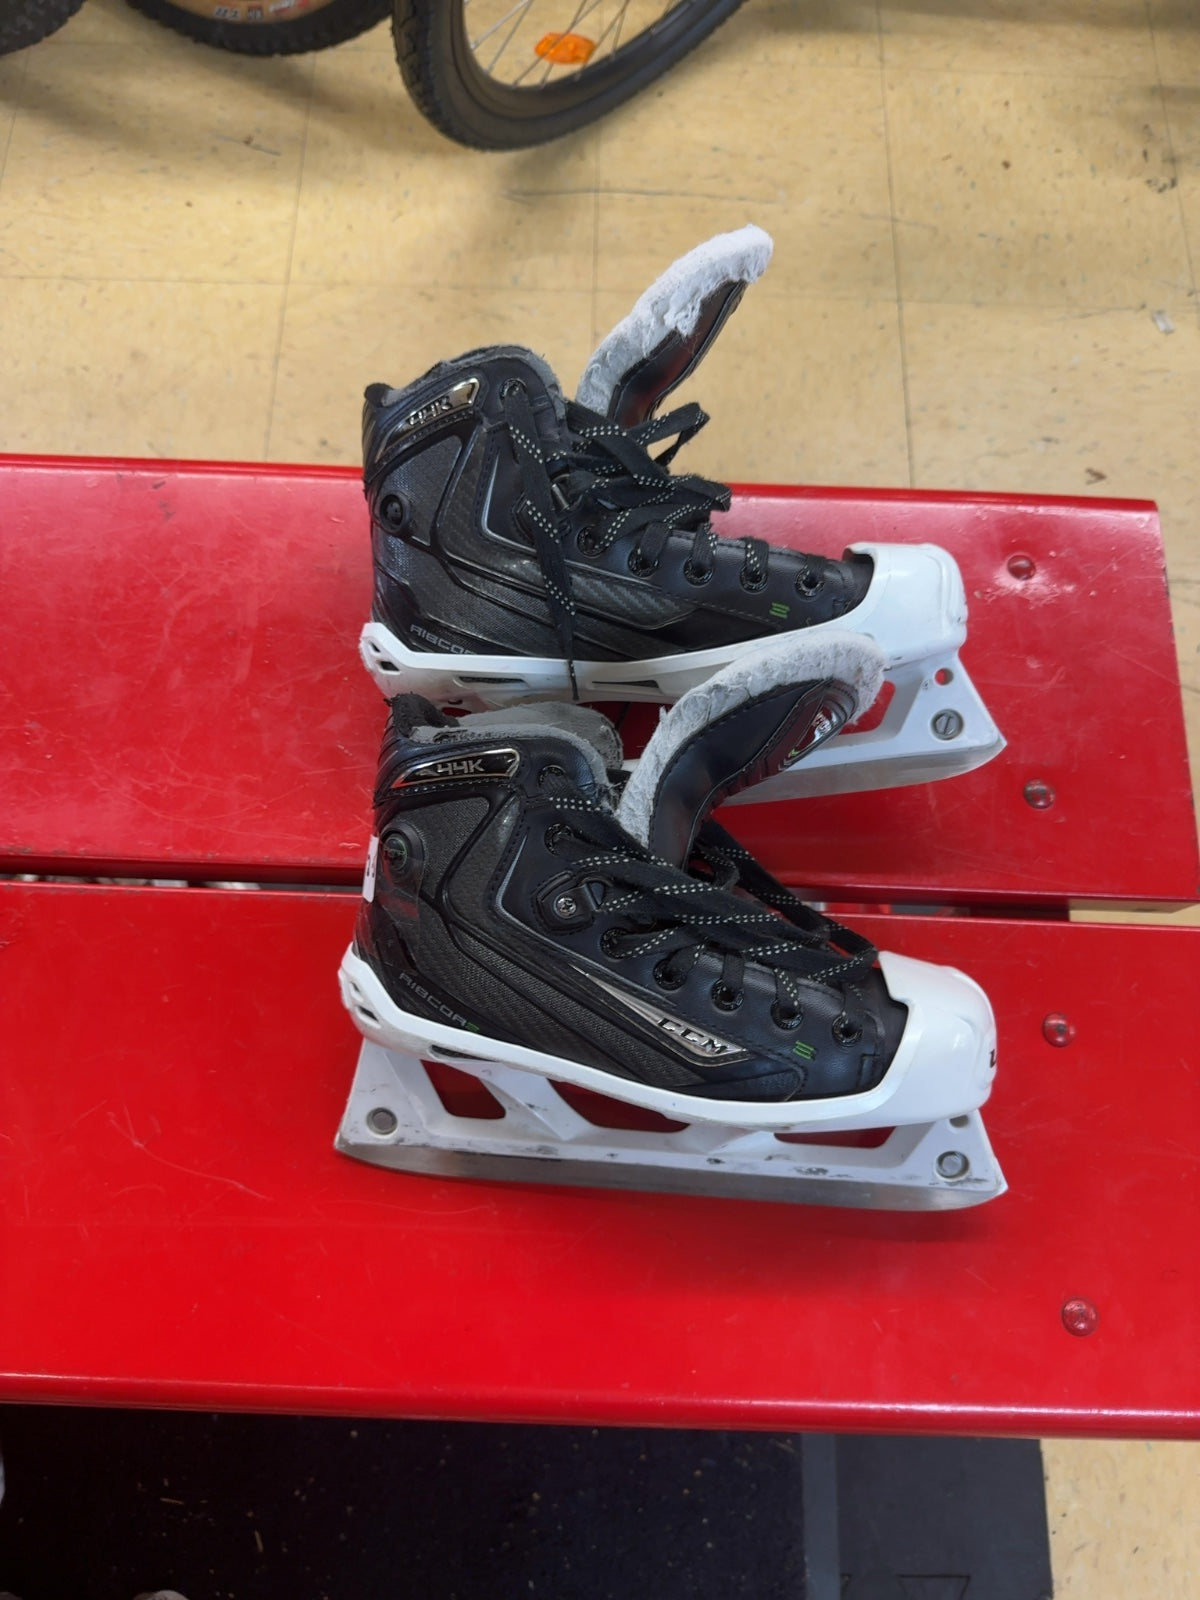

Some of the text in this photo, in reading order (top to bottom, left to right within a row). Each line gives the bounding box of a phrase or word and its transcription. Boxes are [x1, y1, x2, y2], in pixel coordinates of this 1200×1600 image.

[437, 758, 485, 775] 44K
[399, 972, 467, 1027] RIBCOR
[657, 1017, 729, 1055] CCM
